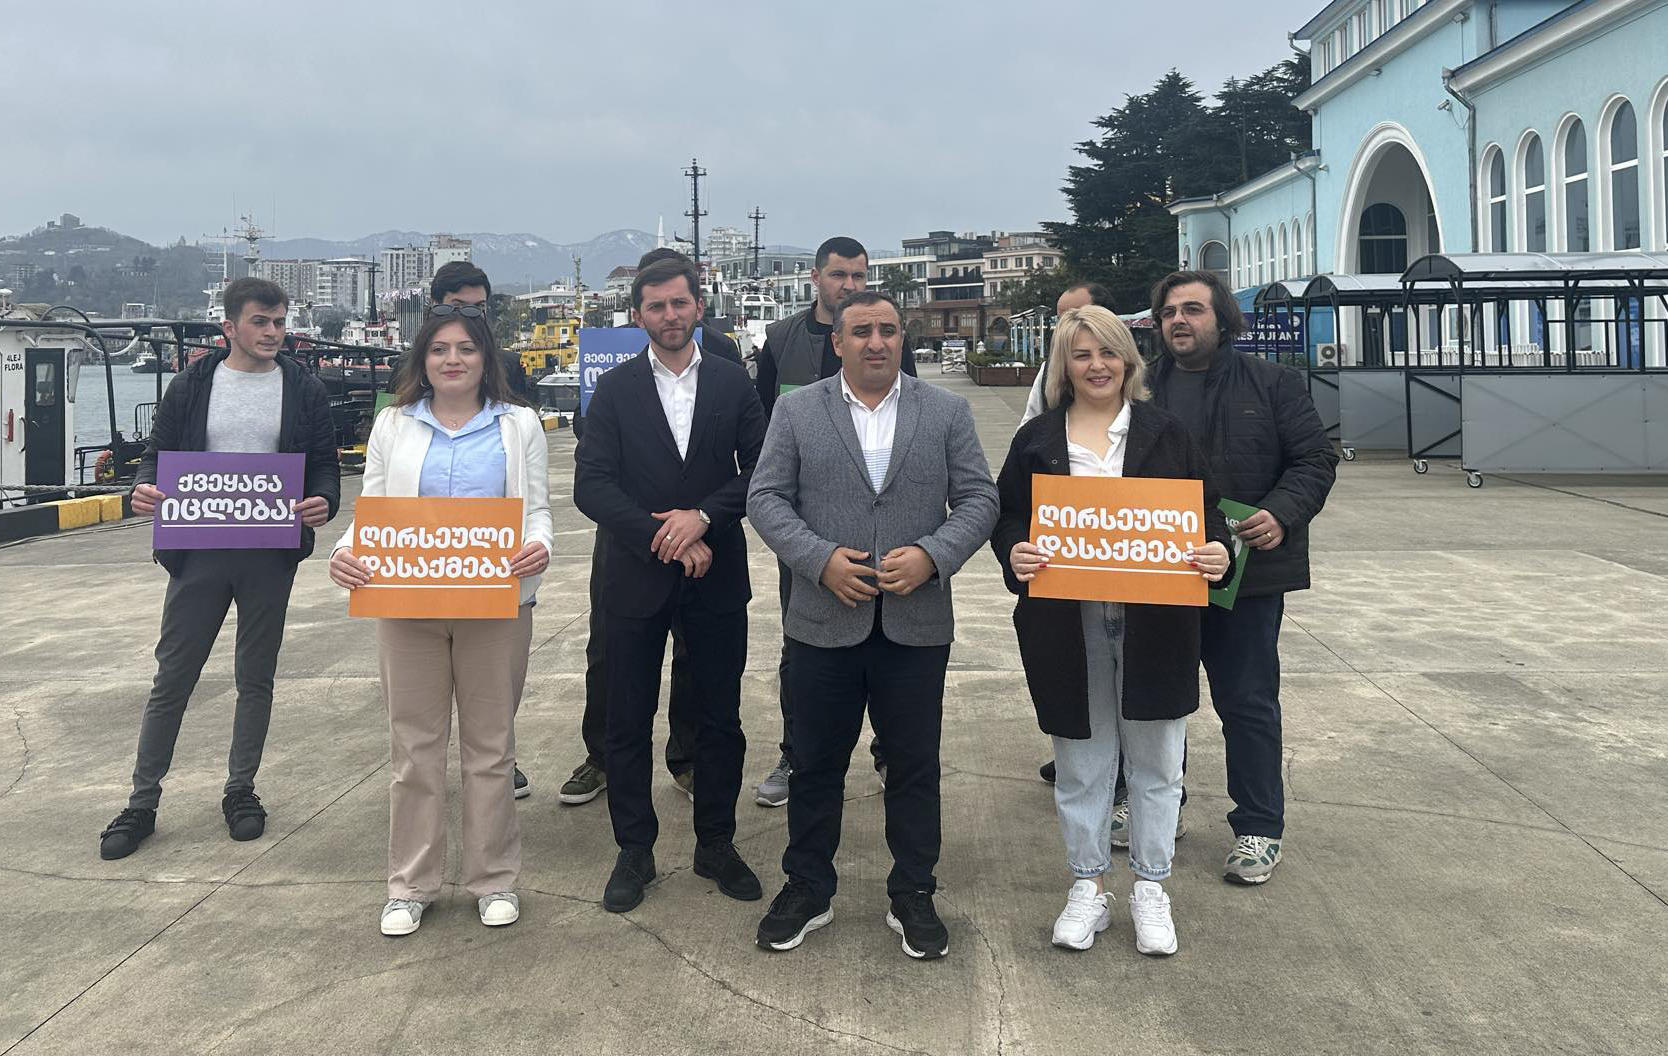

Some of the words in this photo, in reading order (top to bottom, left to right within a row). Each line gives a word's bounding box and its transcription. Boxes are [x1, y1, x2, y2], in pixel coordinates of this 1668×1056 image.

[1234, 331, 1300, 341] ESAURANT
[4, 363, 24, 371] FLORA
[583, 353, 613, 363] მეტი
[177, 473, 283, 493] ქვეყანა
[161, 498, 297, 521] იცლება!
[1037, 504, 1198, 533] ღირსეული
[359, 525, 515, 549] ღირსეული
